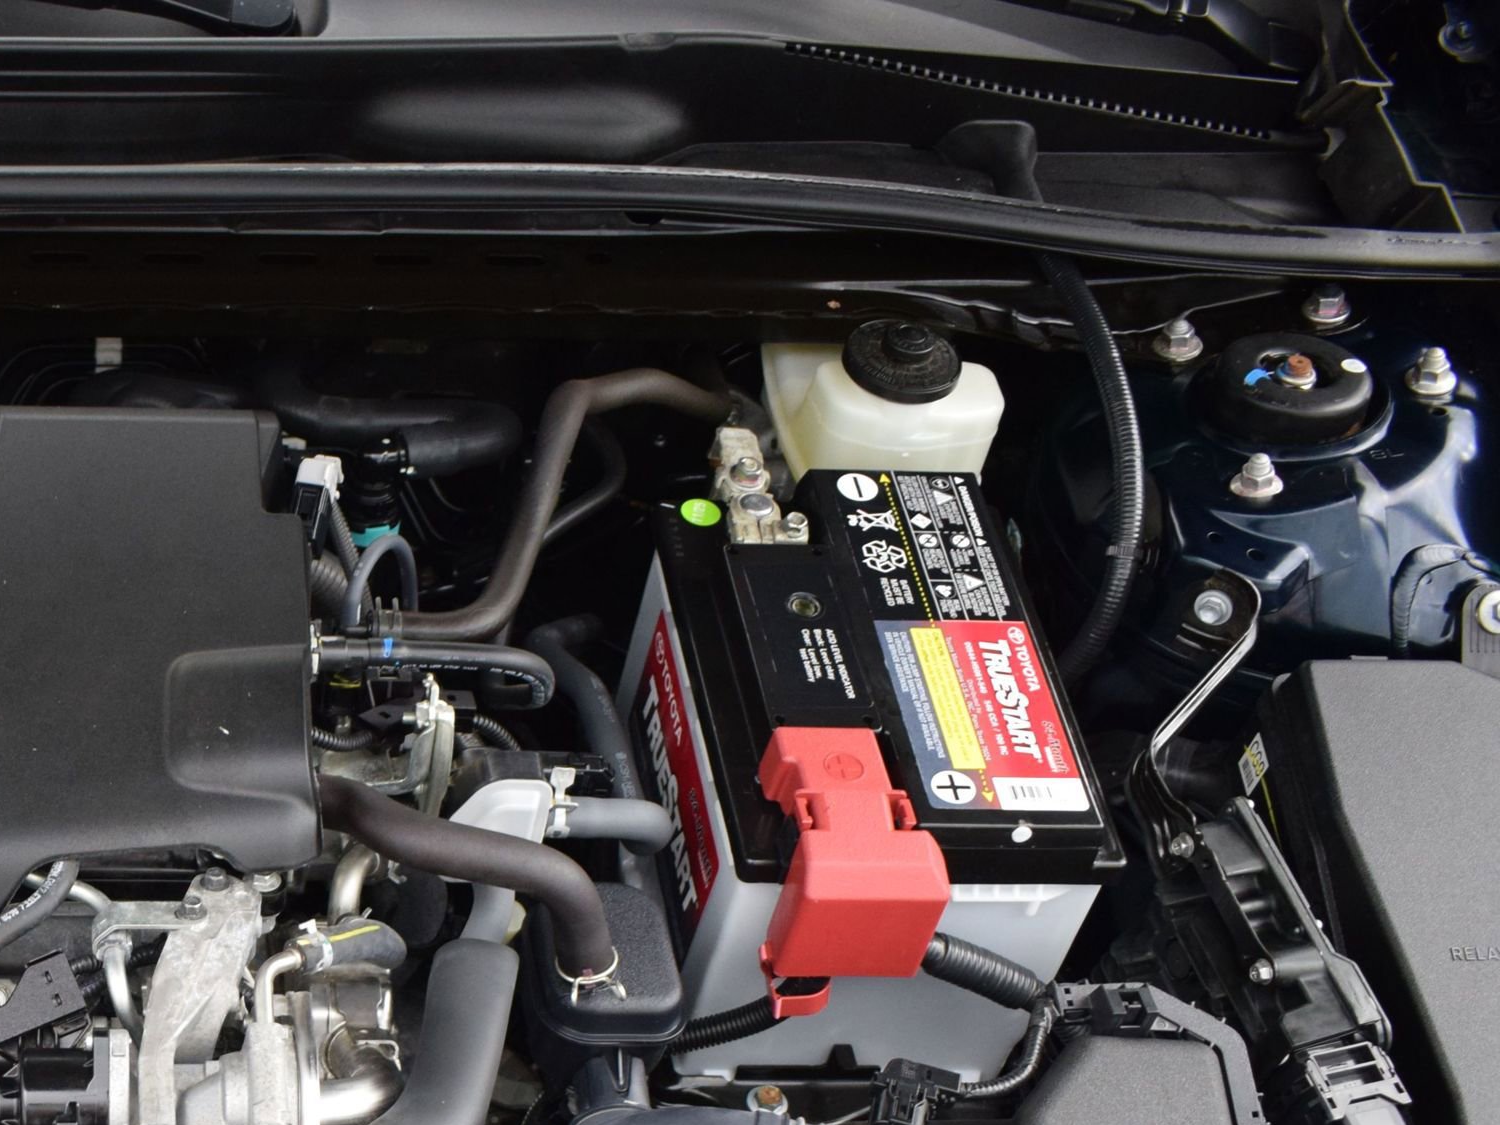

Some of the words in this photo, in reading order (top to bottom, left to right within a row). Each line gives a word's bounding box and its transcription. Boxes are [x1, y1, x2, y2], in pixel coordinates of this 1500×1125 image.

[879, 577, 895, 606] RECYCLED
[889, 578, 902, 595] MUST
[899, 579, 914, 604] BATTERY
[825, 628, 837, 644] ACID
[807, 648, 820, 664] Level
[820, 648, 832, 664] Level
[830, 644, 843, 663] LEVEL
[803, 660, 815, 682] battery
[1017, 646, 1039, 691] TOYOTA
[837, 664, 856, 699] INDICATOR
[663, 659, 682, 747] TOYOTA
[1449, 946, 1500, 961] RELA
